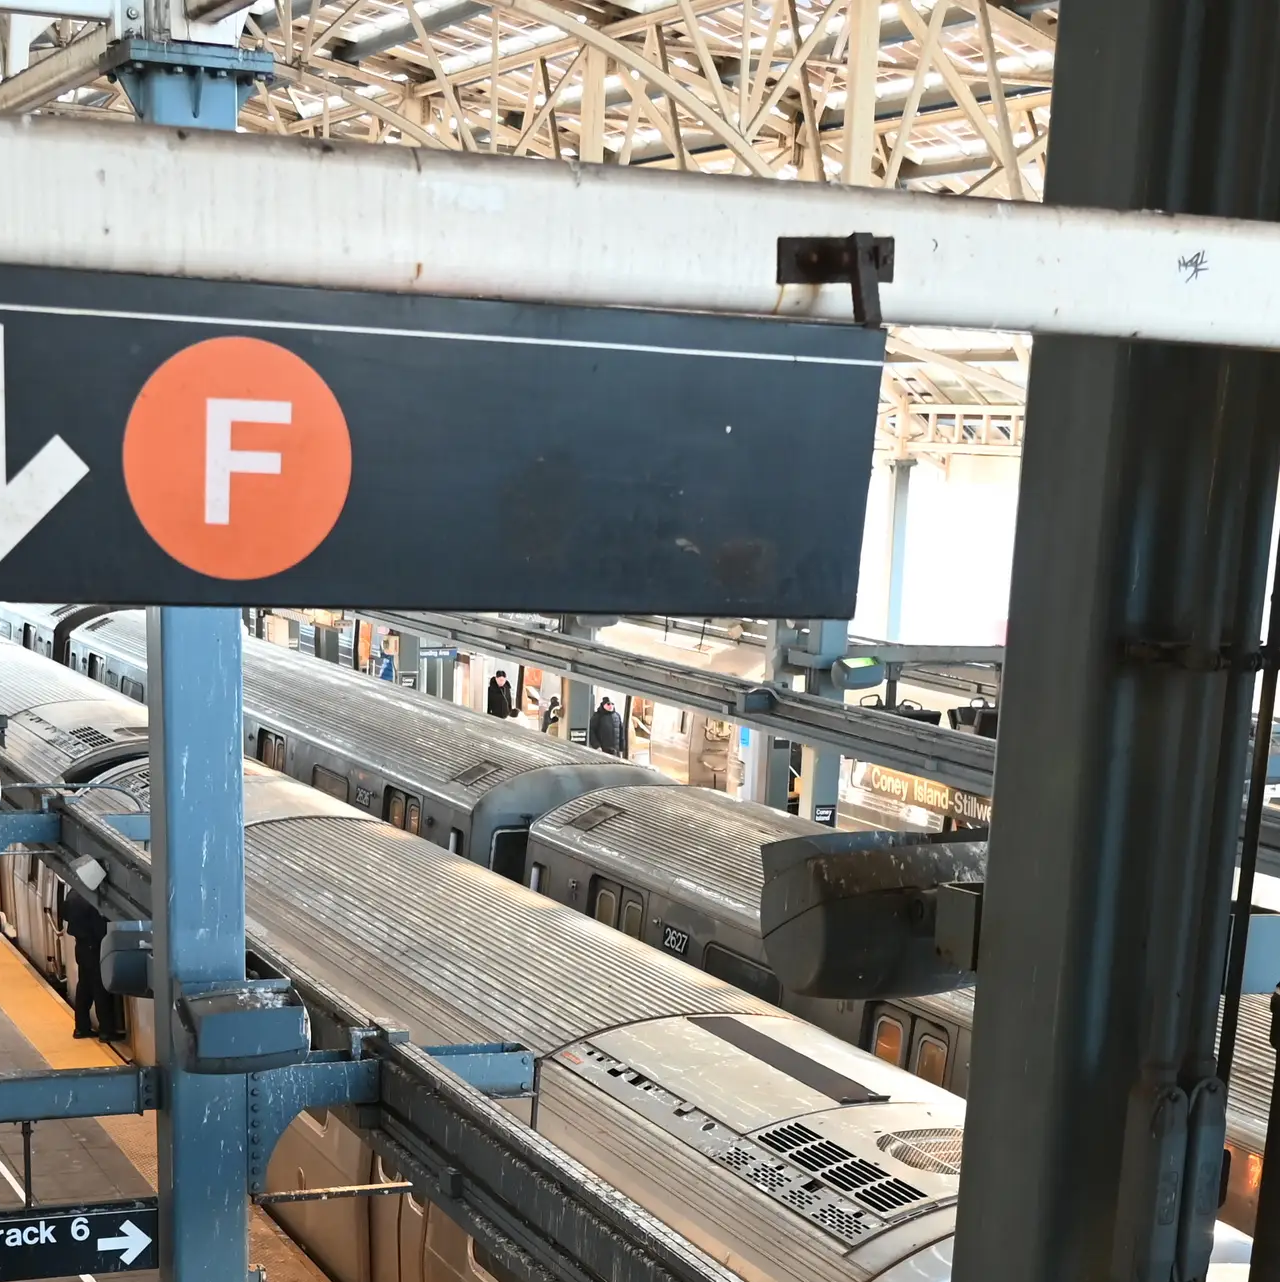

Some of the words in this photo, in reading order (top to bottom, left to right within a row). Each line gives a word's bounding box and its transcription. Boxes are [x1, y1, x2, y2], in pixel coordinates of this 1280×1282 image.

[203, 397, 293, 526] F
[871, 767, 908, 801] Coney
[664, 927, 688, 953] 2627
[70, 1216, 91, 1242] 6
